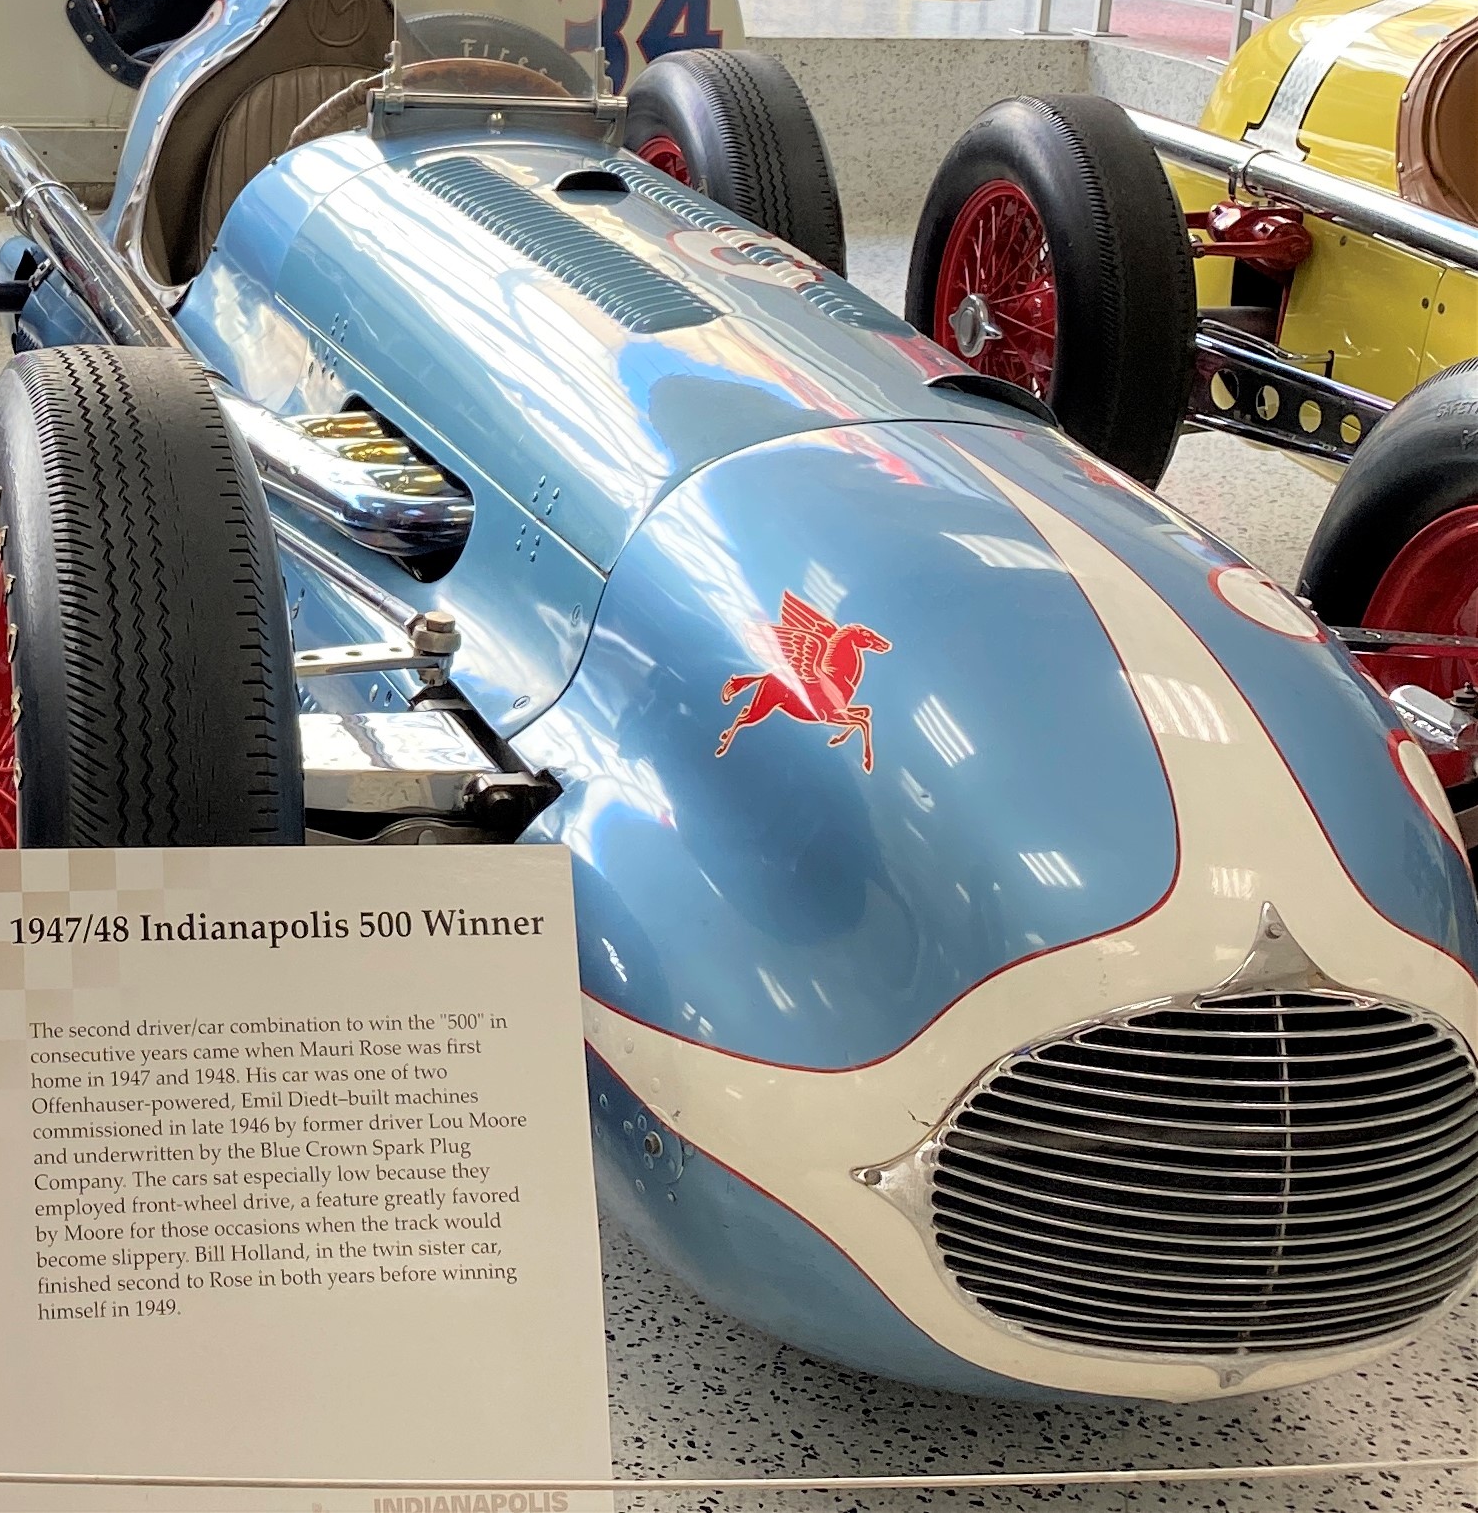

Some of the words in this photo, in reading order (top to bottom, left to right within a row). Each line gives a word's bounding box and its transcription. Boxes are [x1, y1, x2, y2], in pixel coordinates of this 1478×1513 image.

[10, 912, 132, 946] 1947/48
[139, 910, 350, 949] Indianapolis
[359, 910, 412, 938] 500
[420, 908, 545, 937] Winner
[31, 1021, 64, 1039] The
[68, 1019, 131, 1039] second
[136, 1017, 225, 1037] driver/car
[229, 1016, 342, 1035] combination
[346, 1016, 364, 1032] to
[368, 1014, 403, 1031] win
[407, 1013, 436, 1031] the
[439, 1012, 484, 1030] "500"
[489, 1017, 509, 1029] in
[31, 1045, 136, 1064] consecutive
[140, 1048, 188, 1067] years
[193, 1047, 240, 1060] came
[244, 1041, 295, 1059] when
[298, 1040, 355, 1058] Mauri
[358, 1039, 402, 1056] Rose
[406, 1042, 442, 1055] was
[446, 1037, 482, 1055] first
[31, 1072, 82, 1089] home
[87, 1071, 105, 1088] in
[110, 1069, 151, 1087] 1947
[155, 1068, 190, 1086] and
[195, 1067, 240, 1085] 1948.
[245, 1066, 277, 1084] His
[282, 1070, 310, 1083] car
[313, 1069, 349, 1082] was
[353, 1068, 386, 1081] one
[390, 1062, 409, 1081] of
[414, 1065, 448, 1080] two
[31, 1091, 236, 1117] Offenhauser-powered,
[240, 1090, 284, 1109] Emil
[394, 1087, 479, 1105] machines
[32, 1118, 164, 1140] commissioned
[168, 1119, 187, 1136] in
[191, 1118, 225, 1135] late
[229, 1117, 270, 1134] 1946
[274, 1115, 297, 1139] by
[302, 1115, 364, 1133] former
[368, 1113, 424, 1131] driver
[428, 1112, 465, 1129] Lou
[468, 1111, 527, 1129] Moore
[33, 1147, 68, 1166] and
[72, 1144, 195, 1165] underwritten
[198, 1143, 222, 1166] by
[227, 1142, 256, 1160] the
[260, 1141, 301, 1159] Blue
[305, 1140, 368, 1158] Crown
[372, 1137, 426, 1162] Spark
[429, 1137, 472, 1160] Plug
[34, 1173, 127, 1196] Company.
[131, 1170, 167, 1188] The
[171, 1173, 208, 1187] cars
[213, 1169, 239, 1186] sat
[243, 1165, 332, 1190] especially
[336, 1164, 371, 1182] low
[375, 1163, 447, 1181] because
[452, 1161, 491, 1184] they
[34, 1196, 127, 1222] employed
[132, 1192, 237, 1214] front-wheel
[242, 1192, 295, 1212] drive,
[300, 1196, 311, 1209] a
[315, 1190, 379, 1208] feature
[384, 1187, 446, 1212] greatly
[452, 1185, 521, 1205] favored
[34, 1225, 59, 1248] by
[64, 1224, 124, 1242] Moore
[130, 1221, 156, 1240] for
[160, 1220, 209, 1239] those
[214, 1218, 301, 1237] occasions
[304, 1215, 356, 1234] when
[361, 1214, 389, 1232] the
[394, 1213, 440, 1231] track
[443, 1211, 502, 1230] would
[35, 1250, 107, 1269] become
[112, 1247, 190, 1271] slippery.
[194, 1244, 226, 1263] Bill
[230, 1242, 310, 1263] Holland,
[315, 1242, 334, 1259] in
[339, 1240, 367, 1259] the
[372, 1240, 414, 1258] twin
[418, 1240, 466, 1256] sister
[471, 1242, 502, 1257] car,
[38, 1274, 112, 1295] finished
[117, 1271, 181, 1292] second
[186, 1273, 205, 1289] to
[208, 1271, 253, 1288] Rose
[257, 1269, 277, 1287] in
[280, 1267, 323, 1286] both
[326, 1270, 375, 1291] years
[379, 1264, 437, 1283] before
[441, 1262, 518, 1285] winning
[37, 1300, 107, 1321] himself
[111, 1300, 130, 1318] in
[135, 1298, 182, 1317] 1949.
[373, 1491, 569, 1513] INDIANAPOLIS
